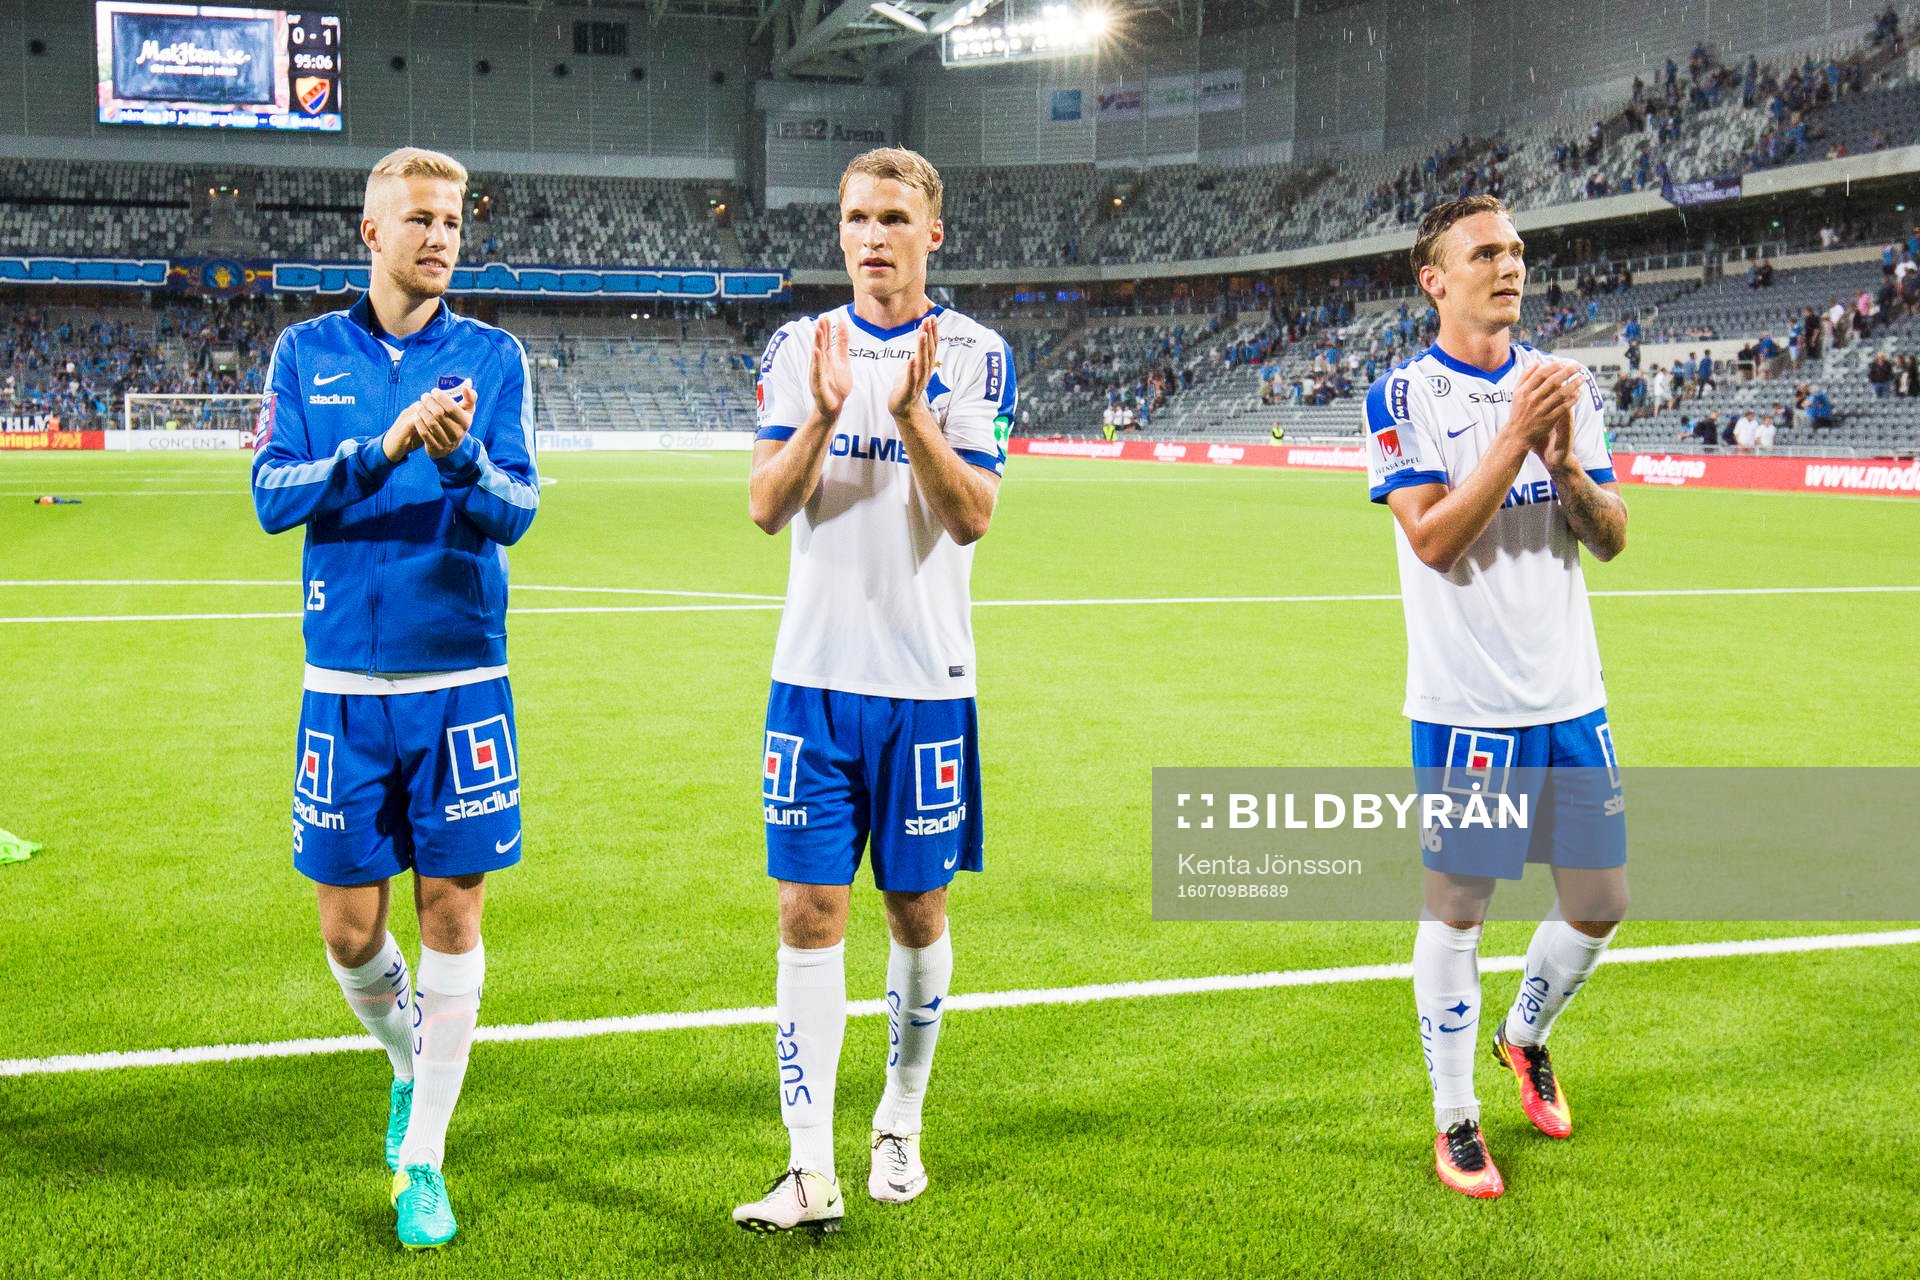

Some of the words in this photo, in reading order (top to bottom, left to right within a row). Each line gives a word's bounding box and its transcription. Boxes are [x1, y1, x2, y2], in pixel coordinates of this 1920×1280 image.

[293, 27, 304, 44] 0
[323, 28, 331, 45] 1
[295, 54, 333, 69] 95:06
[990, 355, 1000, 396] MECA
[309, 393, 355, 405] stadium
[1395, 381, 1405, 417] MECA
[829, 433, 910, 464] OLME
[1375, 462, 1399, 475] SVENSA
[1631, 455, 1706, 479] Moderna
[306, 580, 326, 611] 25
[294, 796, 345, 830] sadium
[764, 804, 807, 826] dium
